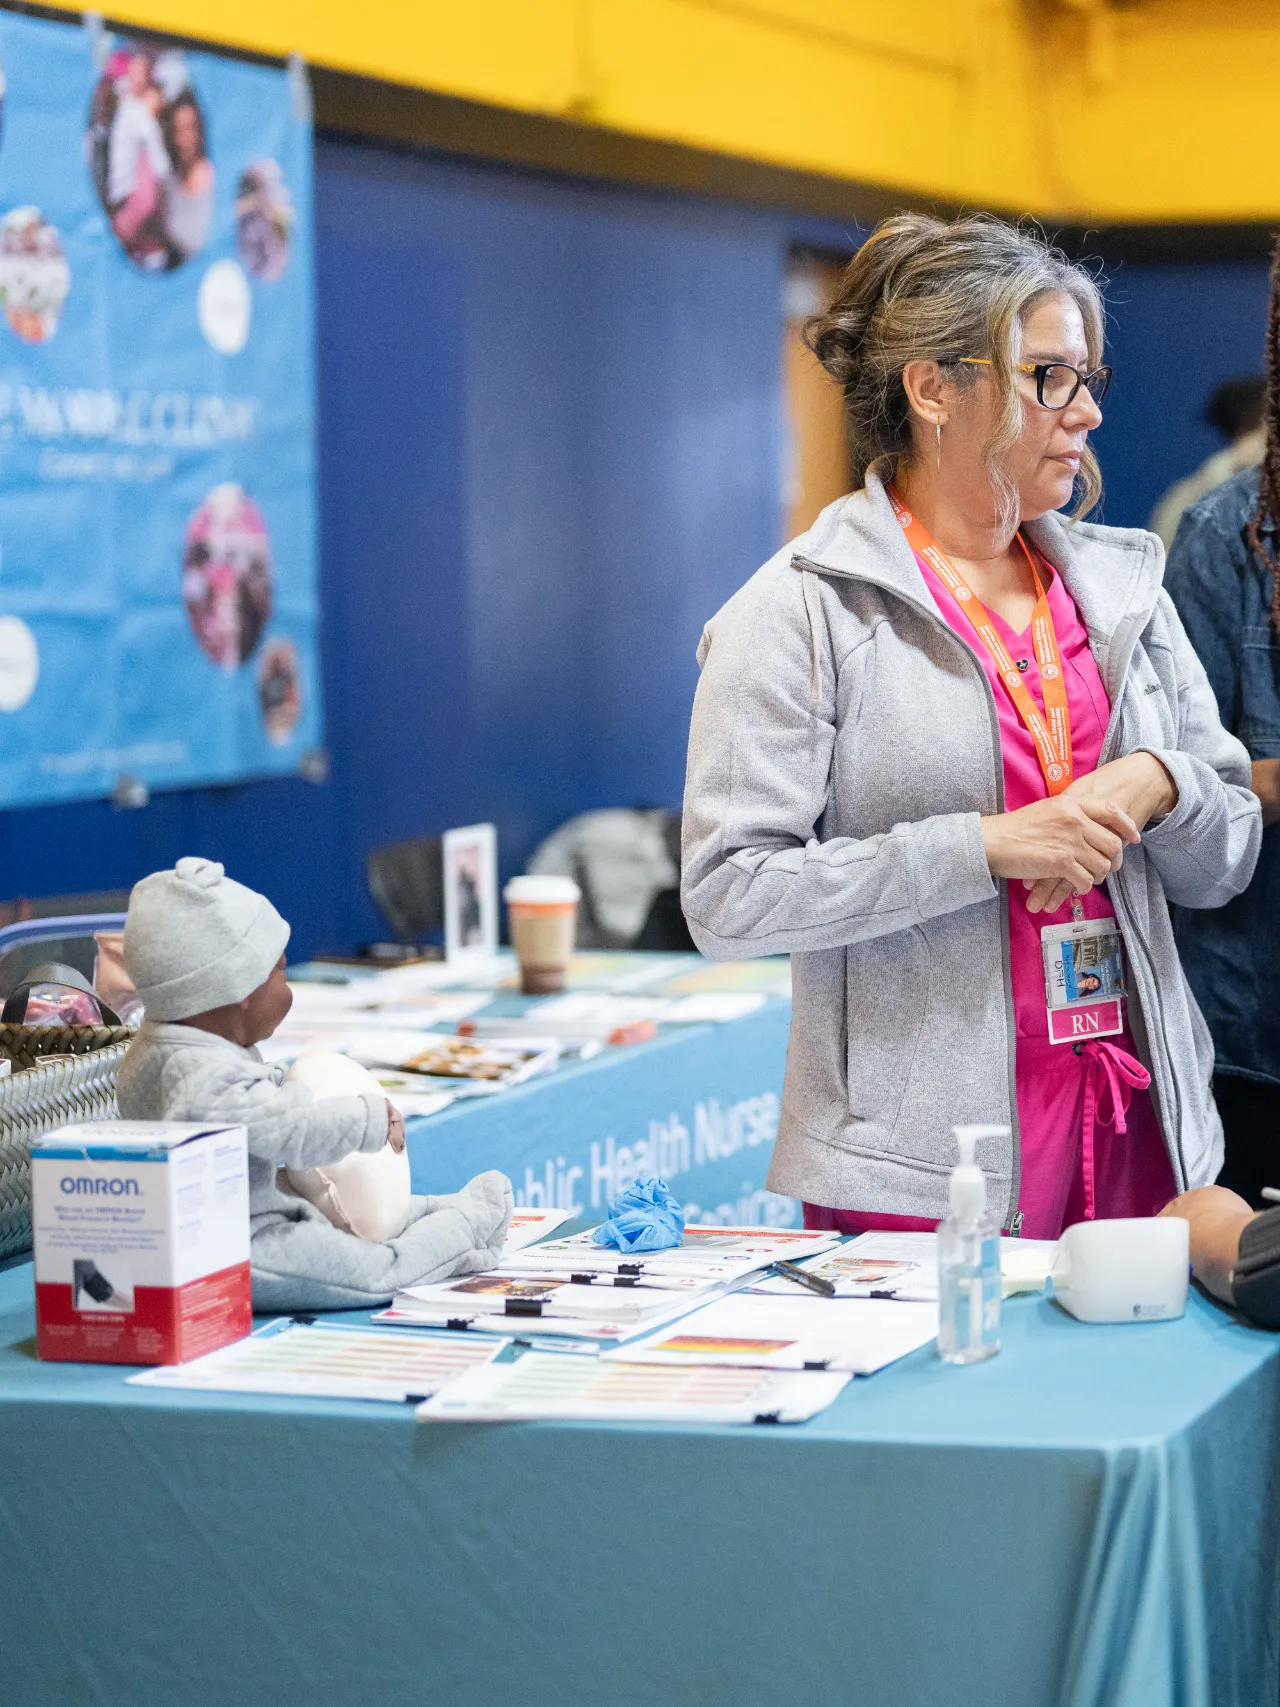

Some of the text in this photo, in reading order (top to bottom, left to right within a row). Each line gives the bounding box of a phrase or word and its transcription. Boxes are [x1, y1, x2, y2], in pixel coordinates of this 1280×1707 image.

[1071, 1011, 1099, 1034] RN
[590, 1111, 690, 1208] Health
[60, 1176, 139, 1196] OMRON
